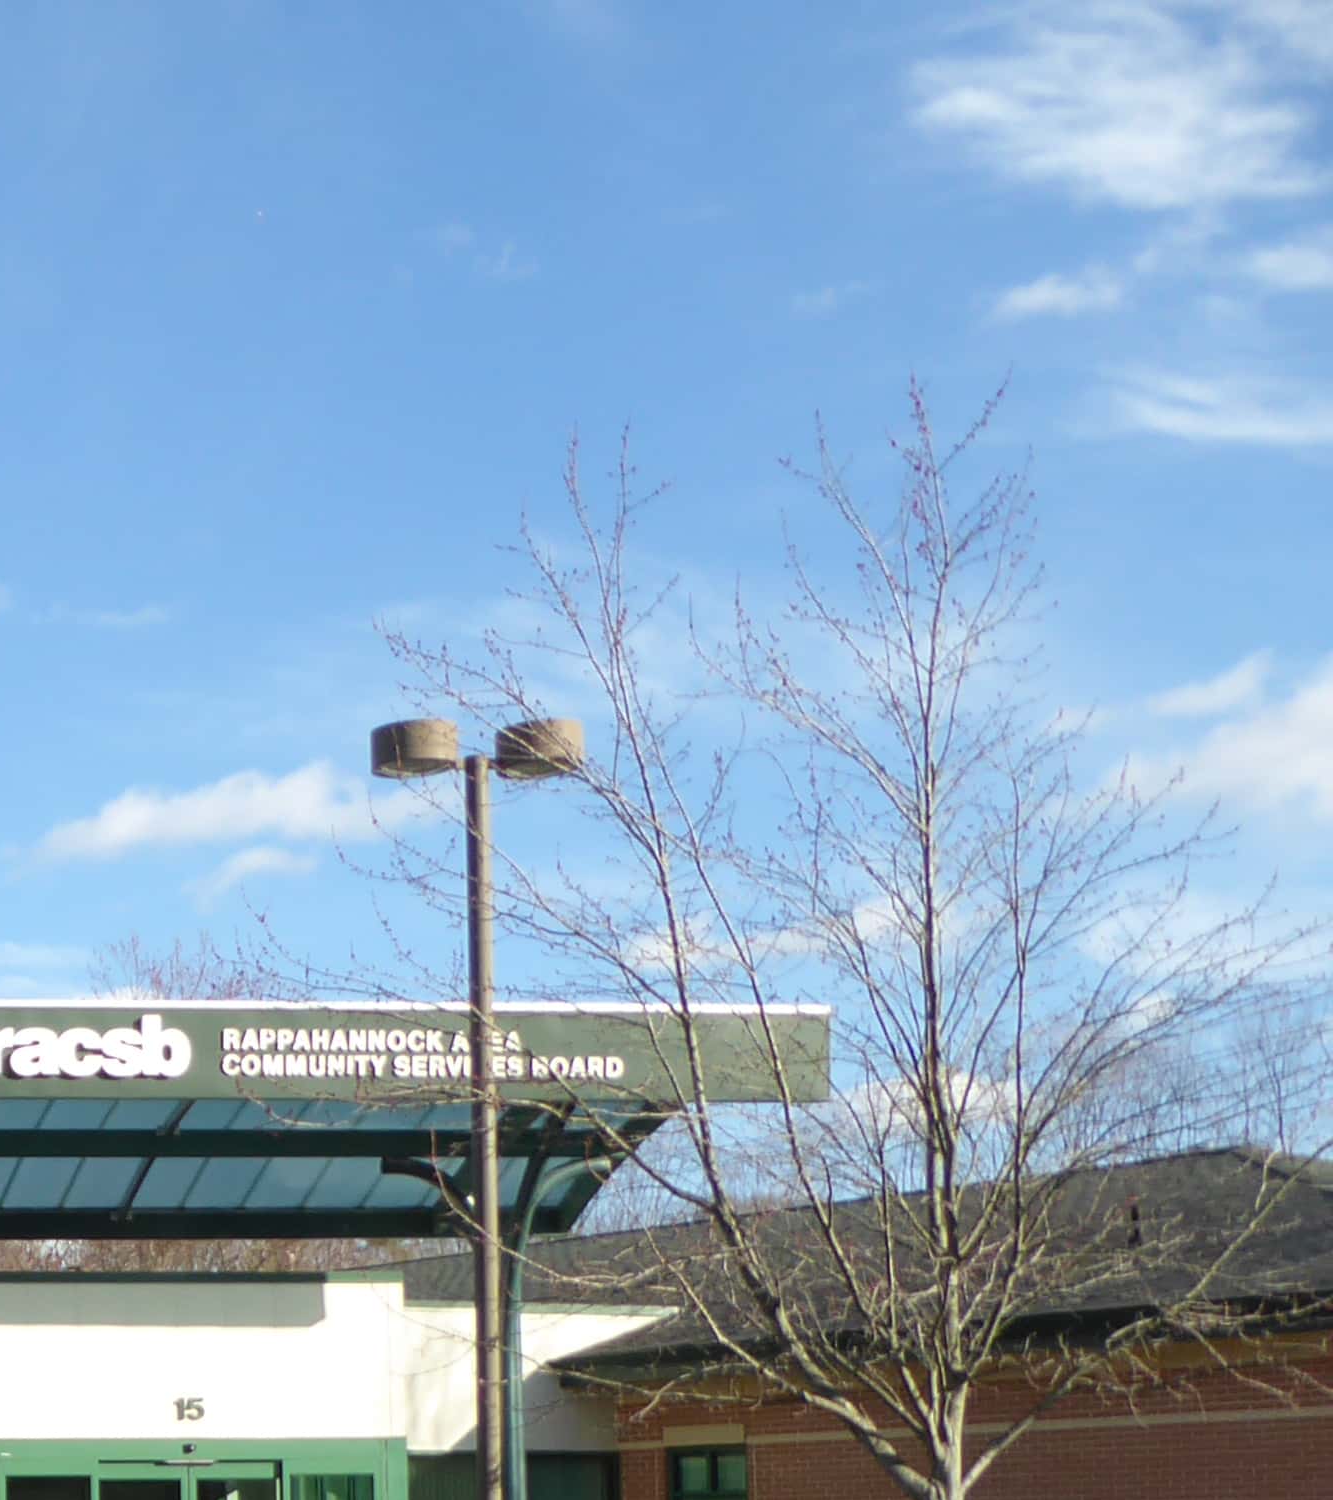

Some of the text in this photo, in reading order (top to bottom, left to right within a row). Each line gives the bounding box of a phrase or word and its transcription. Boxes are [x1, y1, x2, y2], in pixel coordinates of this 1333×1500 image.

[222, 1027, 522, 1053] RAPPAHANNOCK AEA
[222, 1053, 625, 1079] COMMUNITY SERVIES BOARD
[173, 1397, 205, 1421] 15
